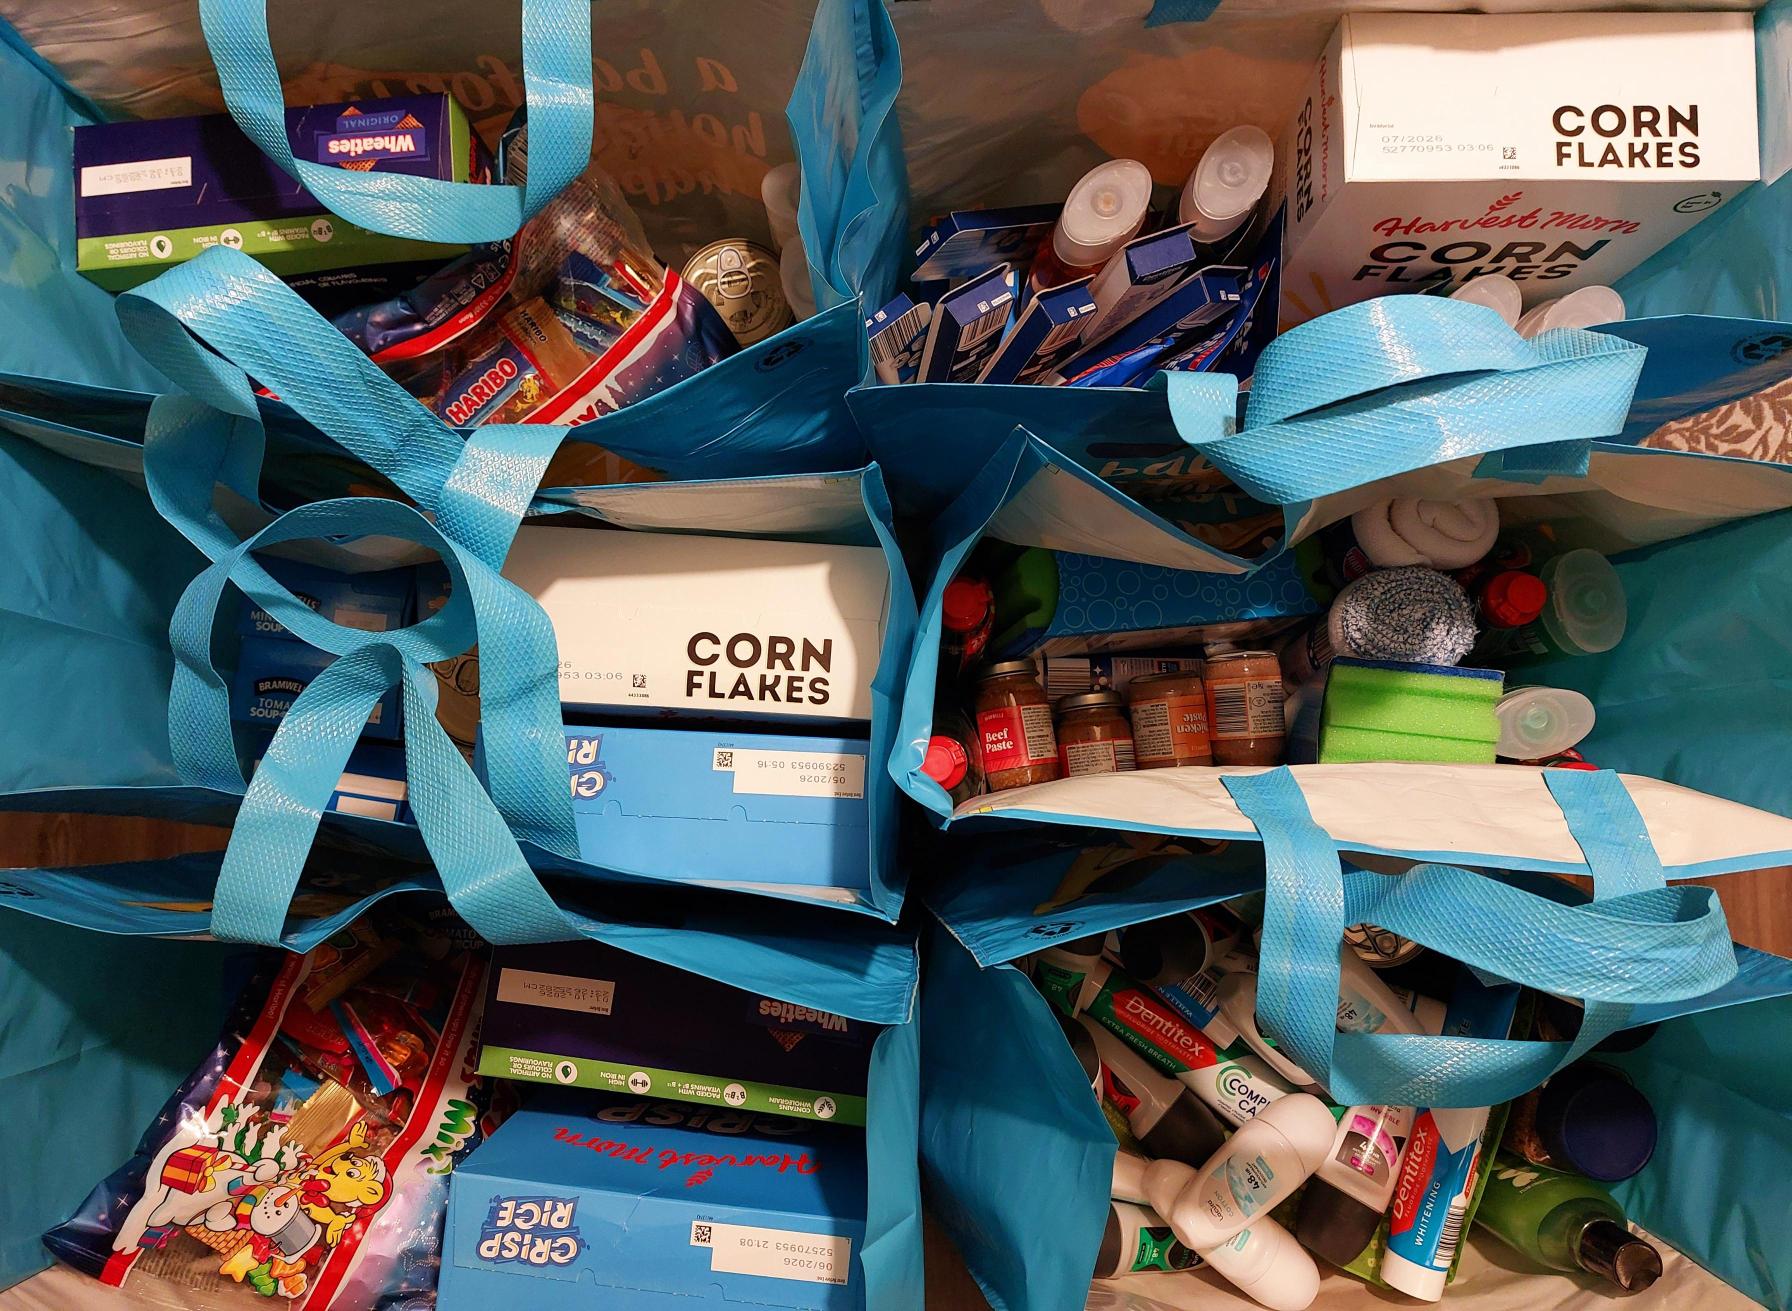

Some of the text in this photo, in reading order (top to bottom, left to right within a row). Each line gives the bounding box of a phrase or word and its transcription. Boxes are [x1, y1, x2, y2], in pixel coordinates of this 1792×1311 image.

[344, 113, 399, 129] ORIGINAL
[1552, 105, 1699, 138] CORN
[328, 134, 416, 155] Wheaties
[1303, 96, 1313, 213] CORN
[1556, 141, 1700, 169] FLAKES
[1373, 207, 1641, 237] Harvest Morn
[1369, 239, 1612, 264] CORN
[519, 310, 548, 345] HARIBO
[445, 358, 518, 425] HARIBO
[686, 632, 833, 672] CORN
[258, 679, 306, 693] BRAMWEL
[584, 672, 623, 681] 03:06
[685, 670, 830, 705] FLAKES
[250, 706, 278, 719] SOUP
[258, 697, 290, 711] TOMA
[985, 728, 1008, 744] Beef
[985, 738, 1014, 754] Paste
[1155, 986, 1196, 1017] WHITEN
[759, 1001, 848, 1033] Wheaties
[1126, 995, 1206, 1059] Dentitex
[1101, 1016, 1177, 1070] EXTRA FRESH BREATH
[509, 1056, 553, 1067] FLAVOURINGS
[524, 1065, 552, 1074] COLOURS
[509, 1067, 552, 1079] NO ARTIFICIAL
[600, 1072, 617, 1080] IRON
[610, 1078, 625, 1087] HIGH
[691, 1083, 722, 1093] VITAMINS
[696, 1090, 722, 1099] PACKED
[1227, 1077, 1272, 1110] COMP
[769, 1097, 812, 1110] WHOLEGRAIN
[777, 1104, 811, 1114] CONTAINS
[1237, 1098, 1259, 1118] CA
[555, 1127, 823, 1175] Harvest Morn
[1245, 1174, 1262, 1191] 48
[1393, 1127, 1428, 1220] Dentitex
[497, 1200, 575, 1227] RICE
[1204, 1198, 1227, 1222] Lacura
[1211, 1190, 1236, 1217] COTTON
[1414, 1181, 1440, 1247] WHITENING
[480, 1233, 578, 1263] CRISP
[739, 1238, 833, 1257] 52570953 21:08
[784, 1257, 833, 1272] 06/2026
